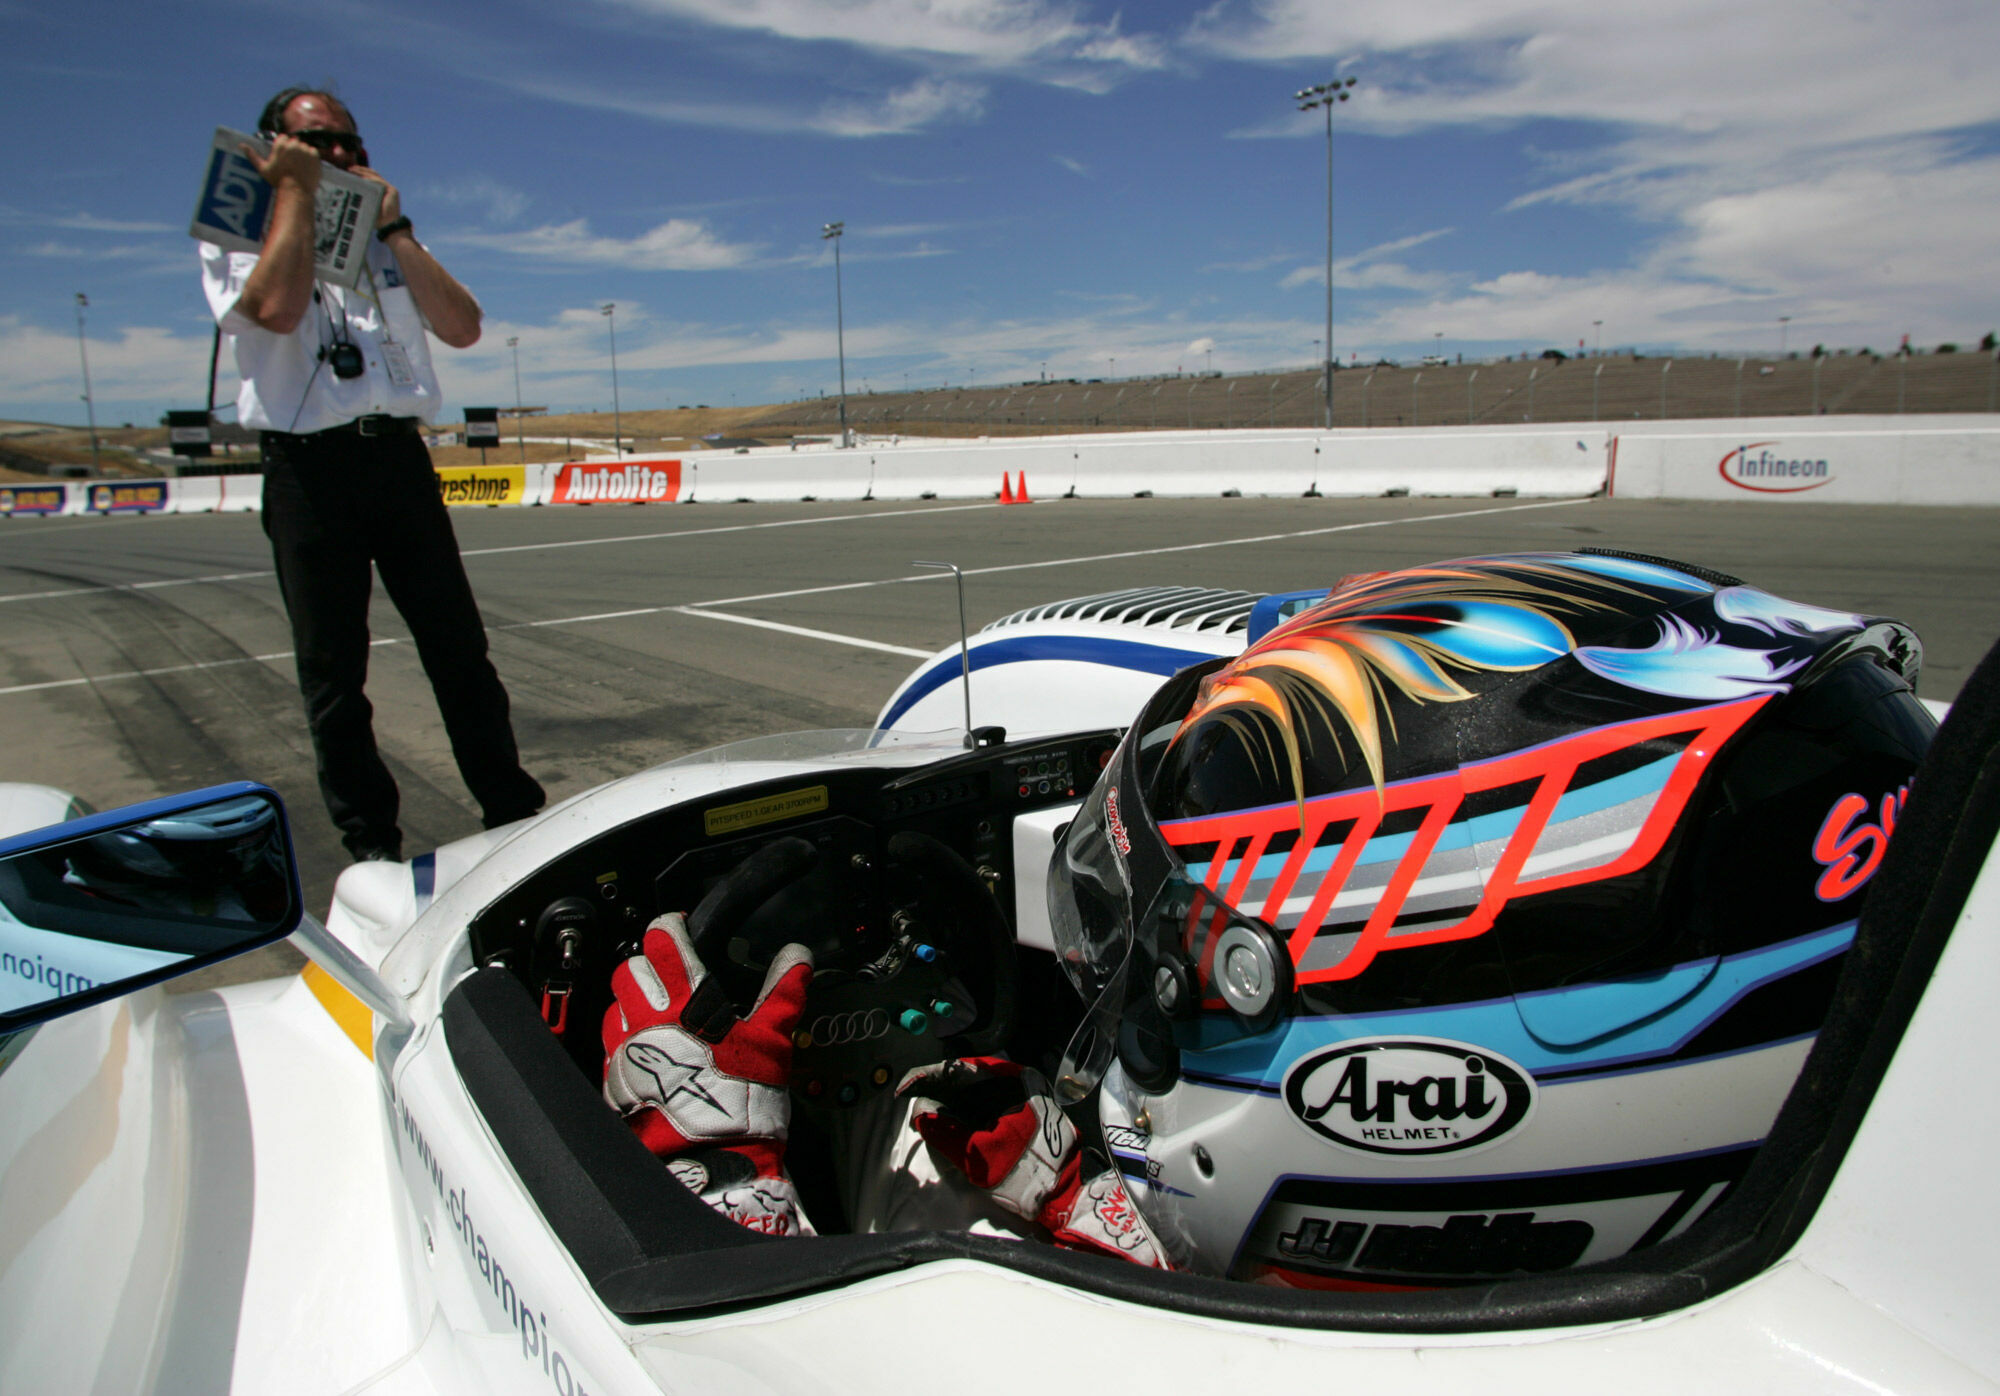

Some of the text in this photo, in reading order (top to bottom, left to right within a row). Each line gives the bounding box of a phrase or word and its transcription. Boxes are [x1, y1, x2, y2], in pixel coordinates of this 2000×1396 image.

[1738, 446, 1828, 477] Infineon
[565, 465, 668, 501] Autolite
[1304, 1055, 1497, 1123] Arai
[1362, 1127, 1450, 1141] HELMET
